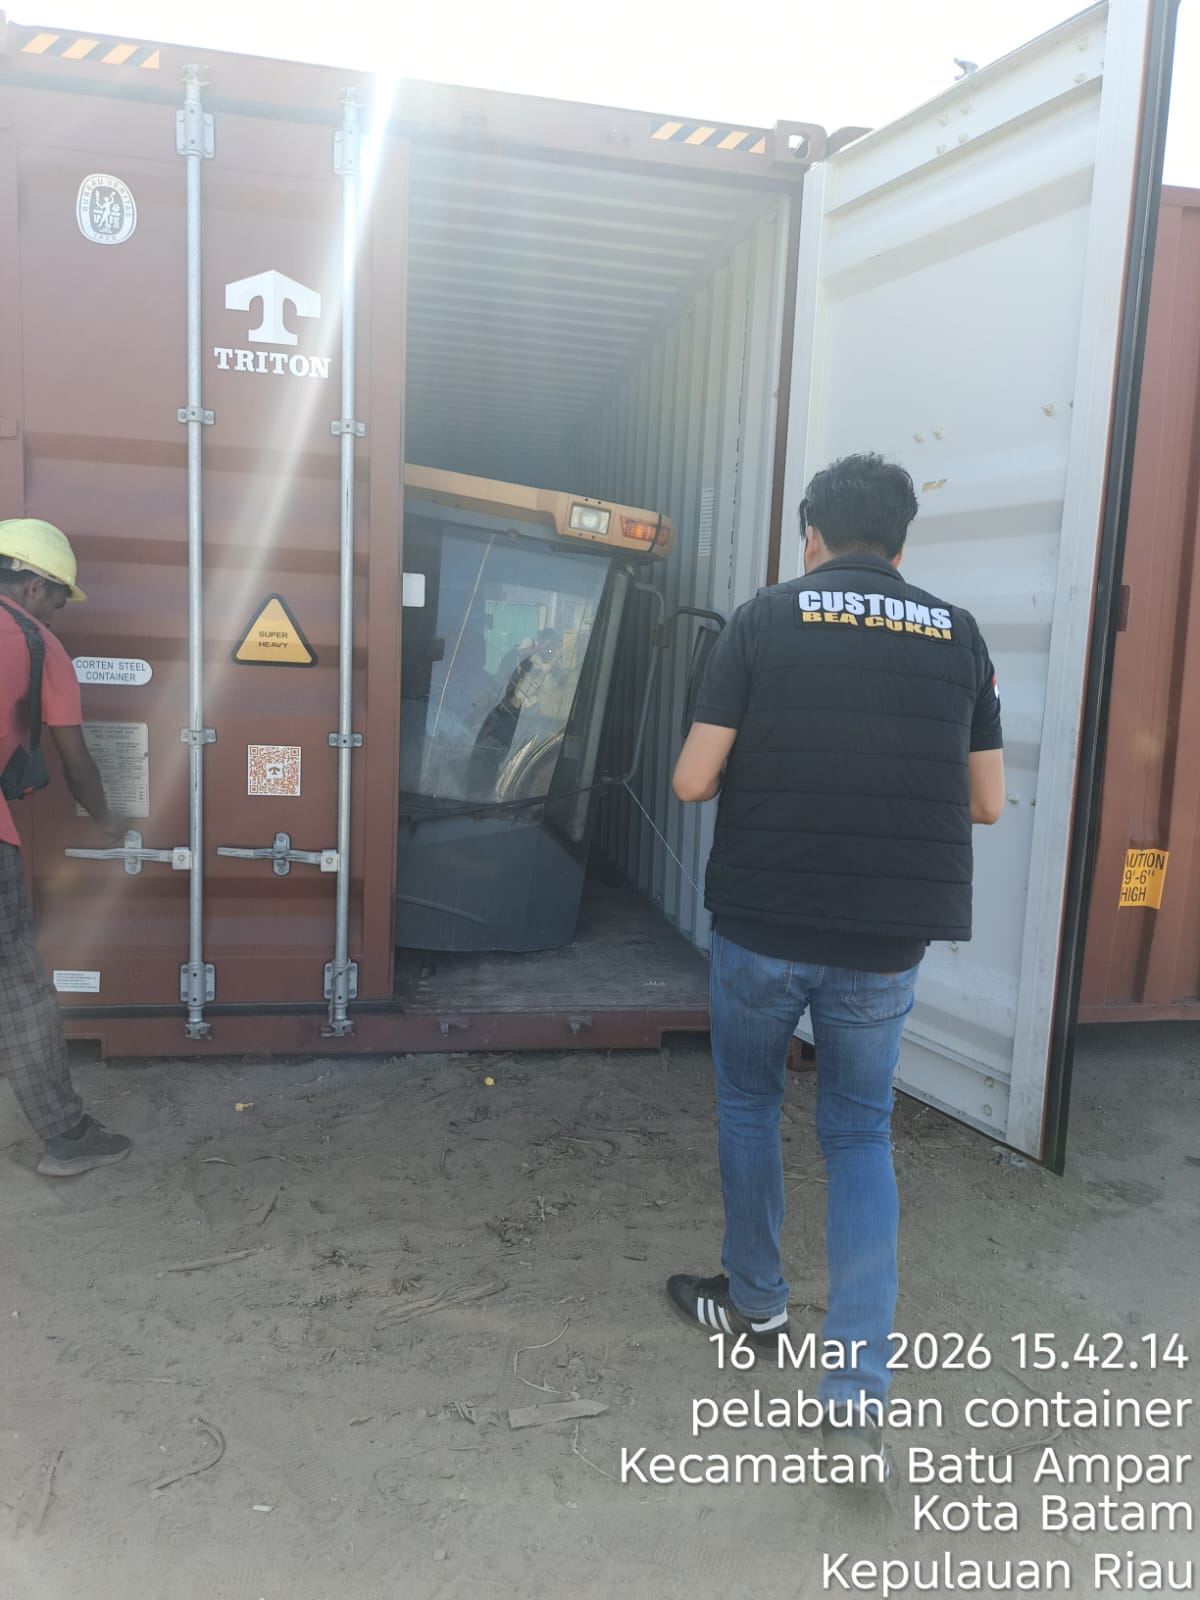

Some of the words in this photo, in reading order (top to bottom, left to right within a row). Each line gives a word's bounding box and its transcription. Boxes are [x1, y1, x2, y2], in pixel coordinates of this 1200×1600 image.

[81, 176, 104, 212] BUREAU
[106, 178, 132, 218] VERITAS
[213, 347, 331, 378] TRITON
[798, 590, 952, 629] CUSTOMS
[258, 630, 289, 639] SUPER
[802, 611, 858, 626] BEA
[864, 616, 952, 641] CUKAI
[258, 641, 289, 649] HEAVY
[75, 660, 114, 670] CORTEN
[118, 662, 147, 672] STEEL
[85, 671, 137, 681] CONTAINER
